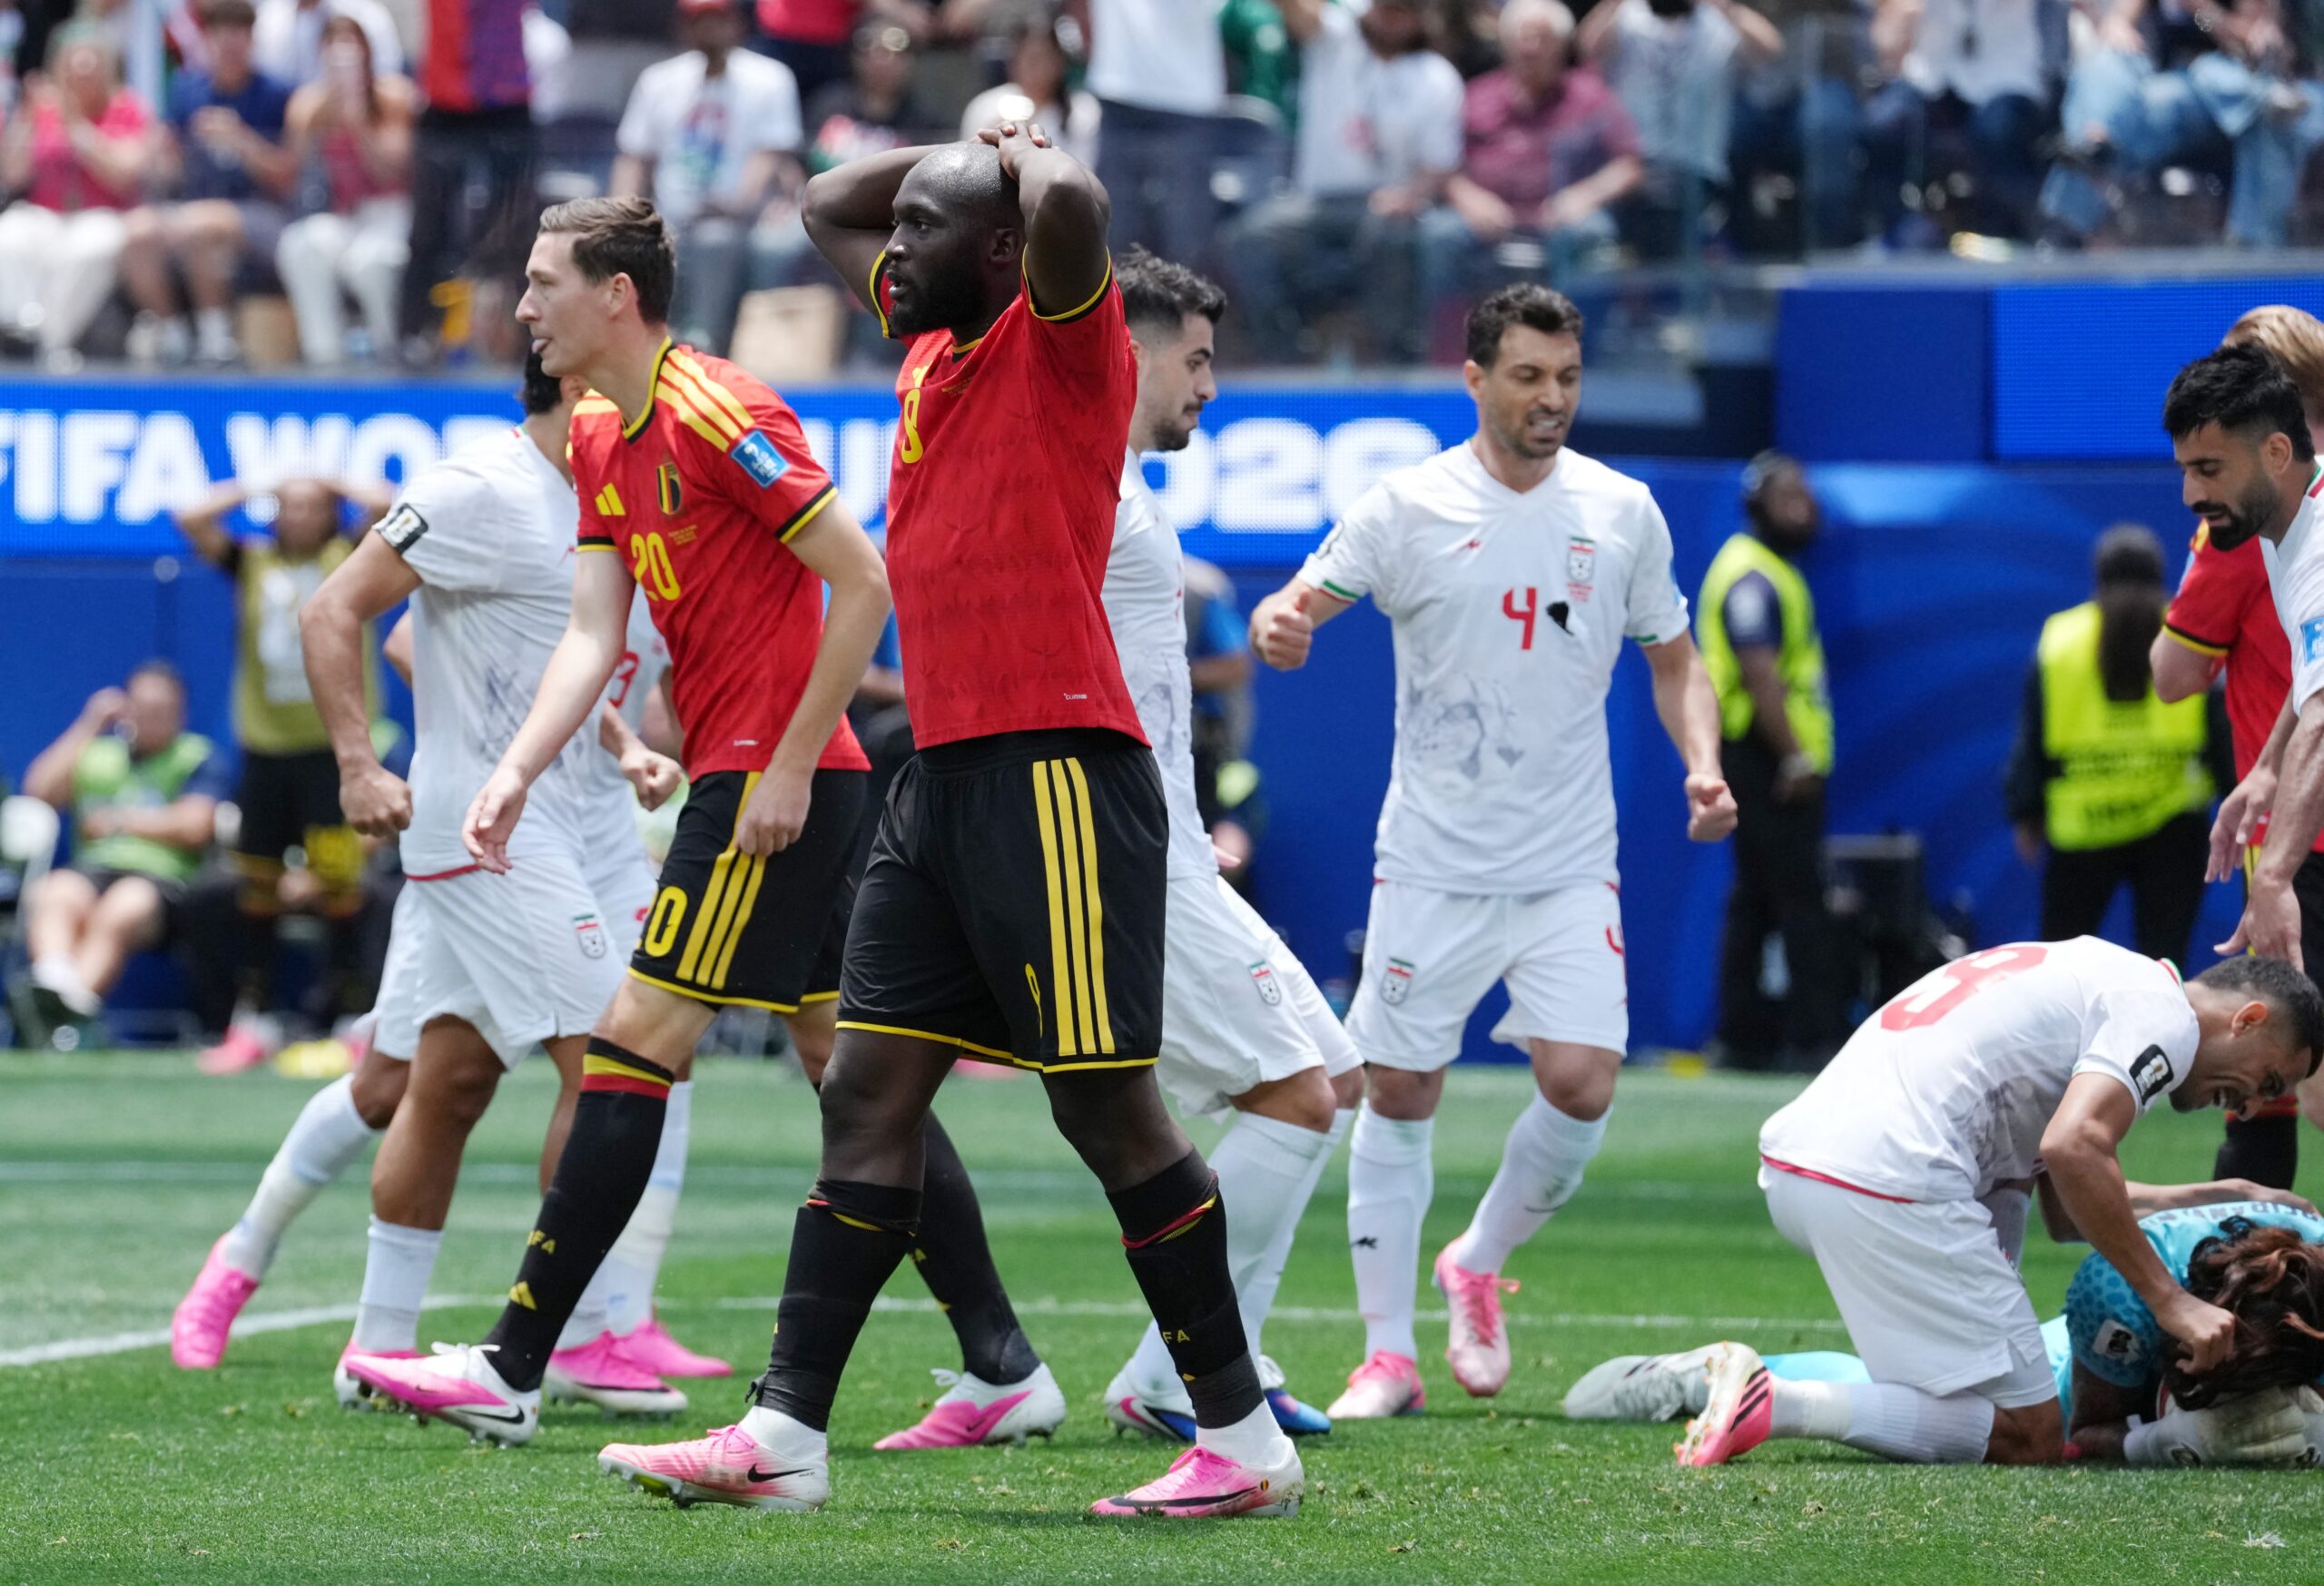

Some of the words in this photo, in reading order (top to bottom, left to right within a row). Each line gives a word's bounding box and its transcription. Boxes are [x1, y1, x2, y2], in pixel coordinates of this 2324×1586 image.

[0, 409, 211, 525] IFA
[631, 531, 681, 601] 20
[1502, 587, 1537, 651] 4
[636, 885, 688, 957] 0
